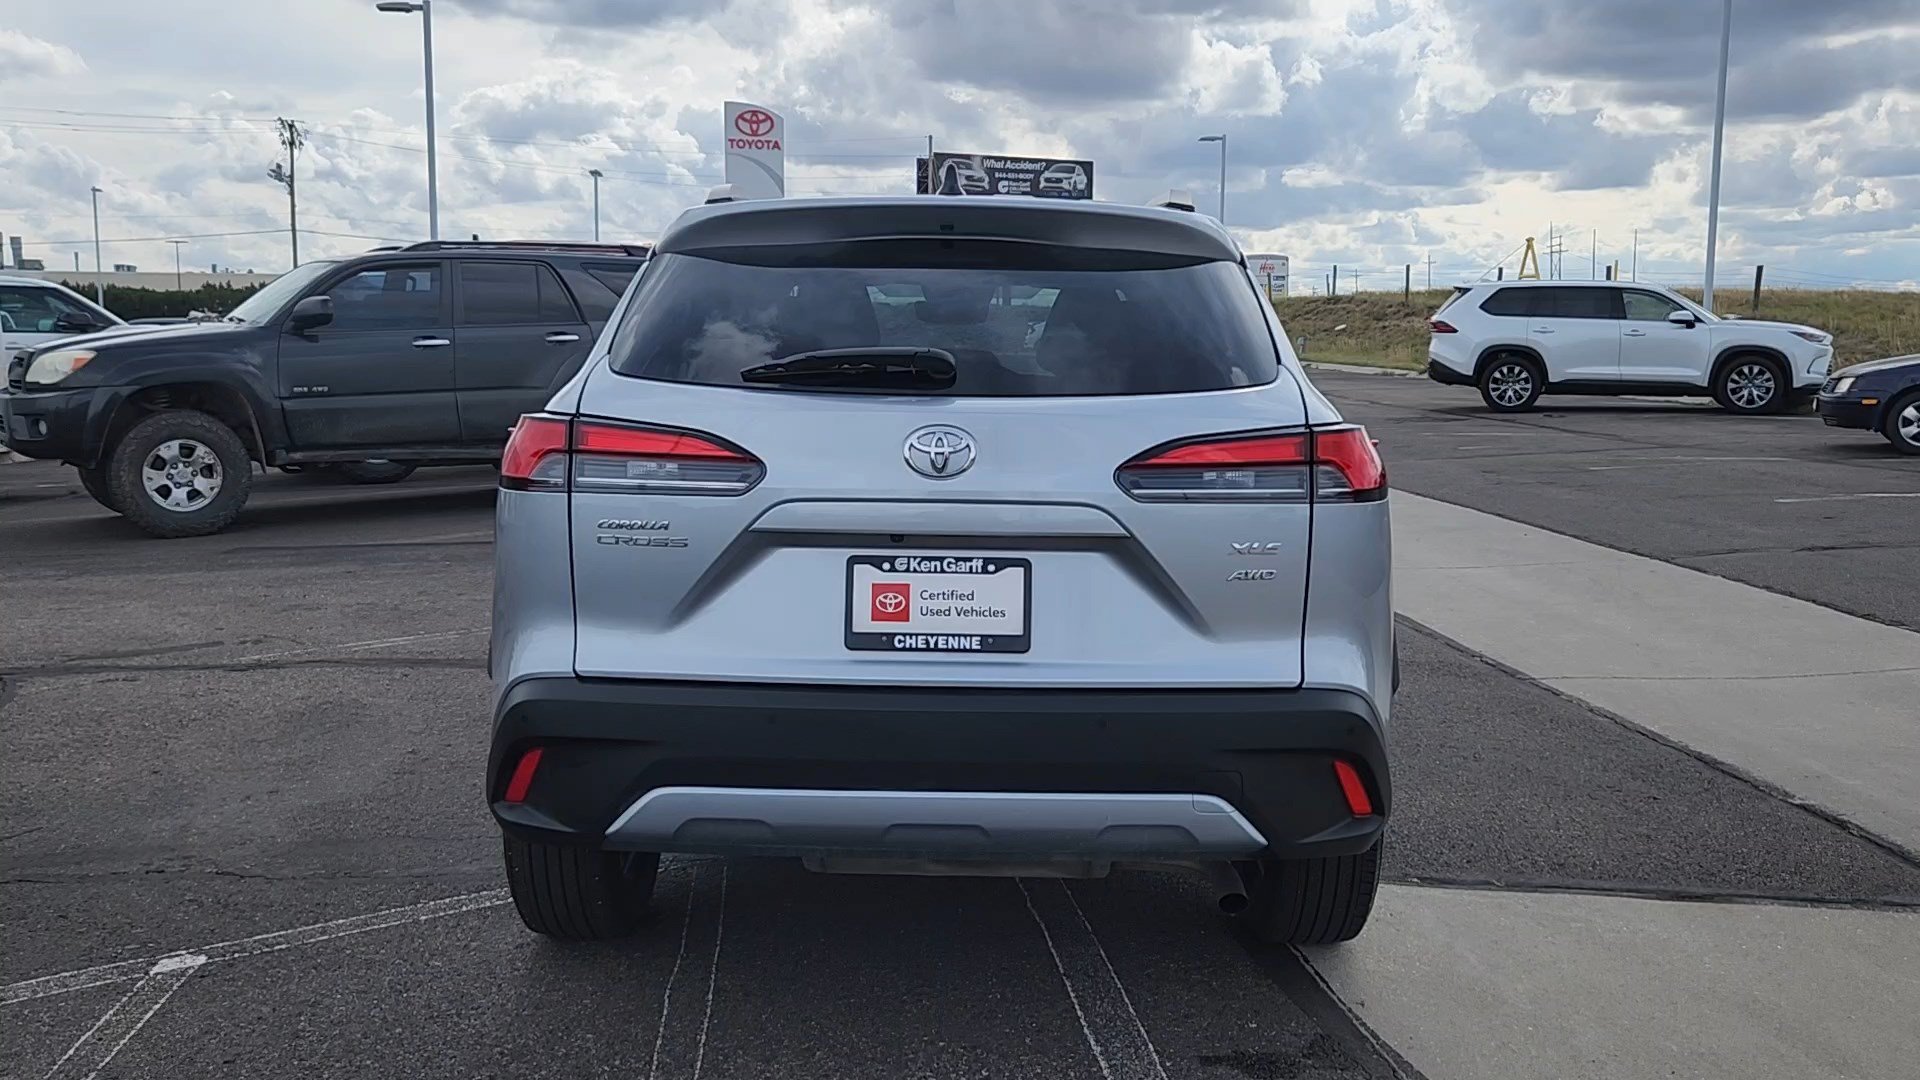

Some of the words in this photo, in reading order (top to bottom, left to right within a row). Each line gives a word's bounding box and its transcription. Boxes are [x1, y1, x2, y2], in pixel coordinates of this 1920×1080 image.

[728, 139, 781, 151] TOYOTA
[983, 159, 1004, 168] What
[1005, 160, 1046, 171] Accident?
[597, 519, 669, 530] COROLLA
[597, 534, 688, 548] CROSS
[909, 558, 941, 572] Ken
[942, 558, 984, 573] Garff
[1226, 569, 1277, 581] AWD
[919, 590, 975, 601] Certified
[919, 606, 951, 617] Used
[954, 607, 1006, 618] Vehicles
[893, 635, 982, 650] CHEYENNE
